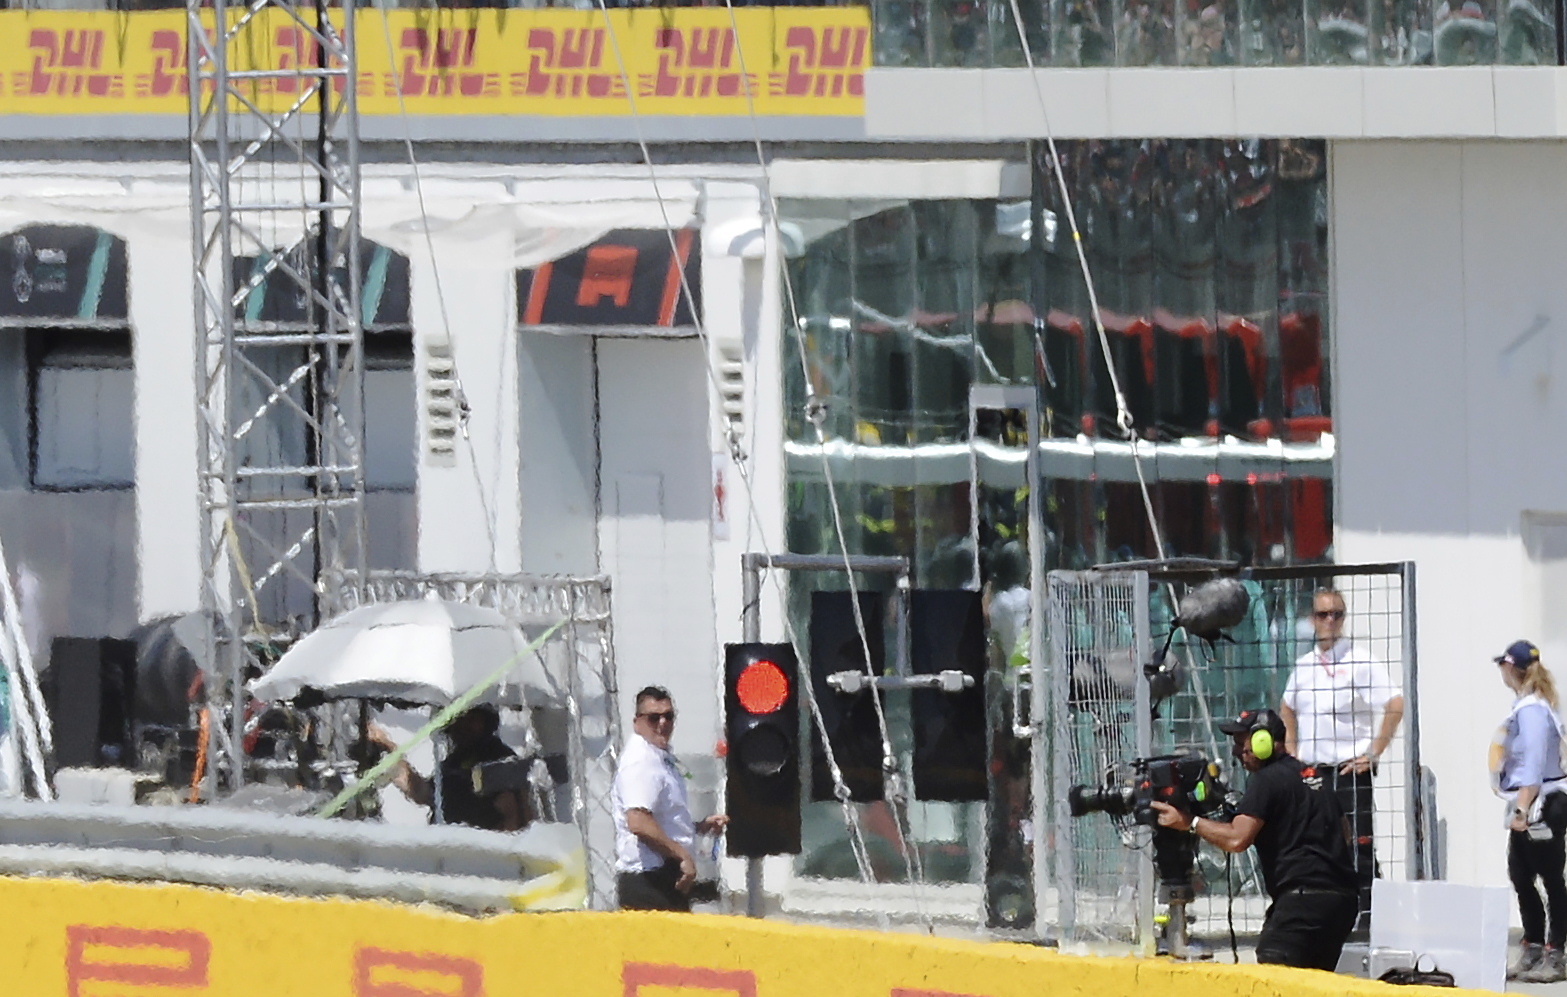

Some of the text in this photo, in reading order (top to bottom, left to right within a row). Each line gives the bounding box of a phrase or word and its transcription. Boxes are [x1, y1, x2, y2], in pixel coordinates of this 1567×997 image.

[29, 30, 112, 98] DHL
[400, 28, 485, 98] DHL
[526, 28, 612, 98] DHL
[655, 27, 744, 98] DHL
[785, 27, 866, 99] DHL
